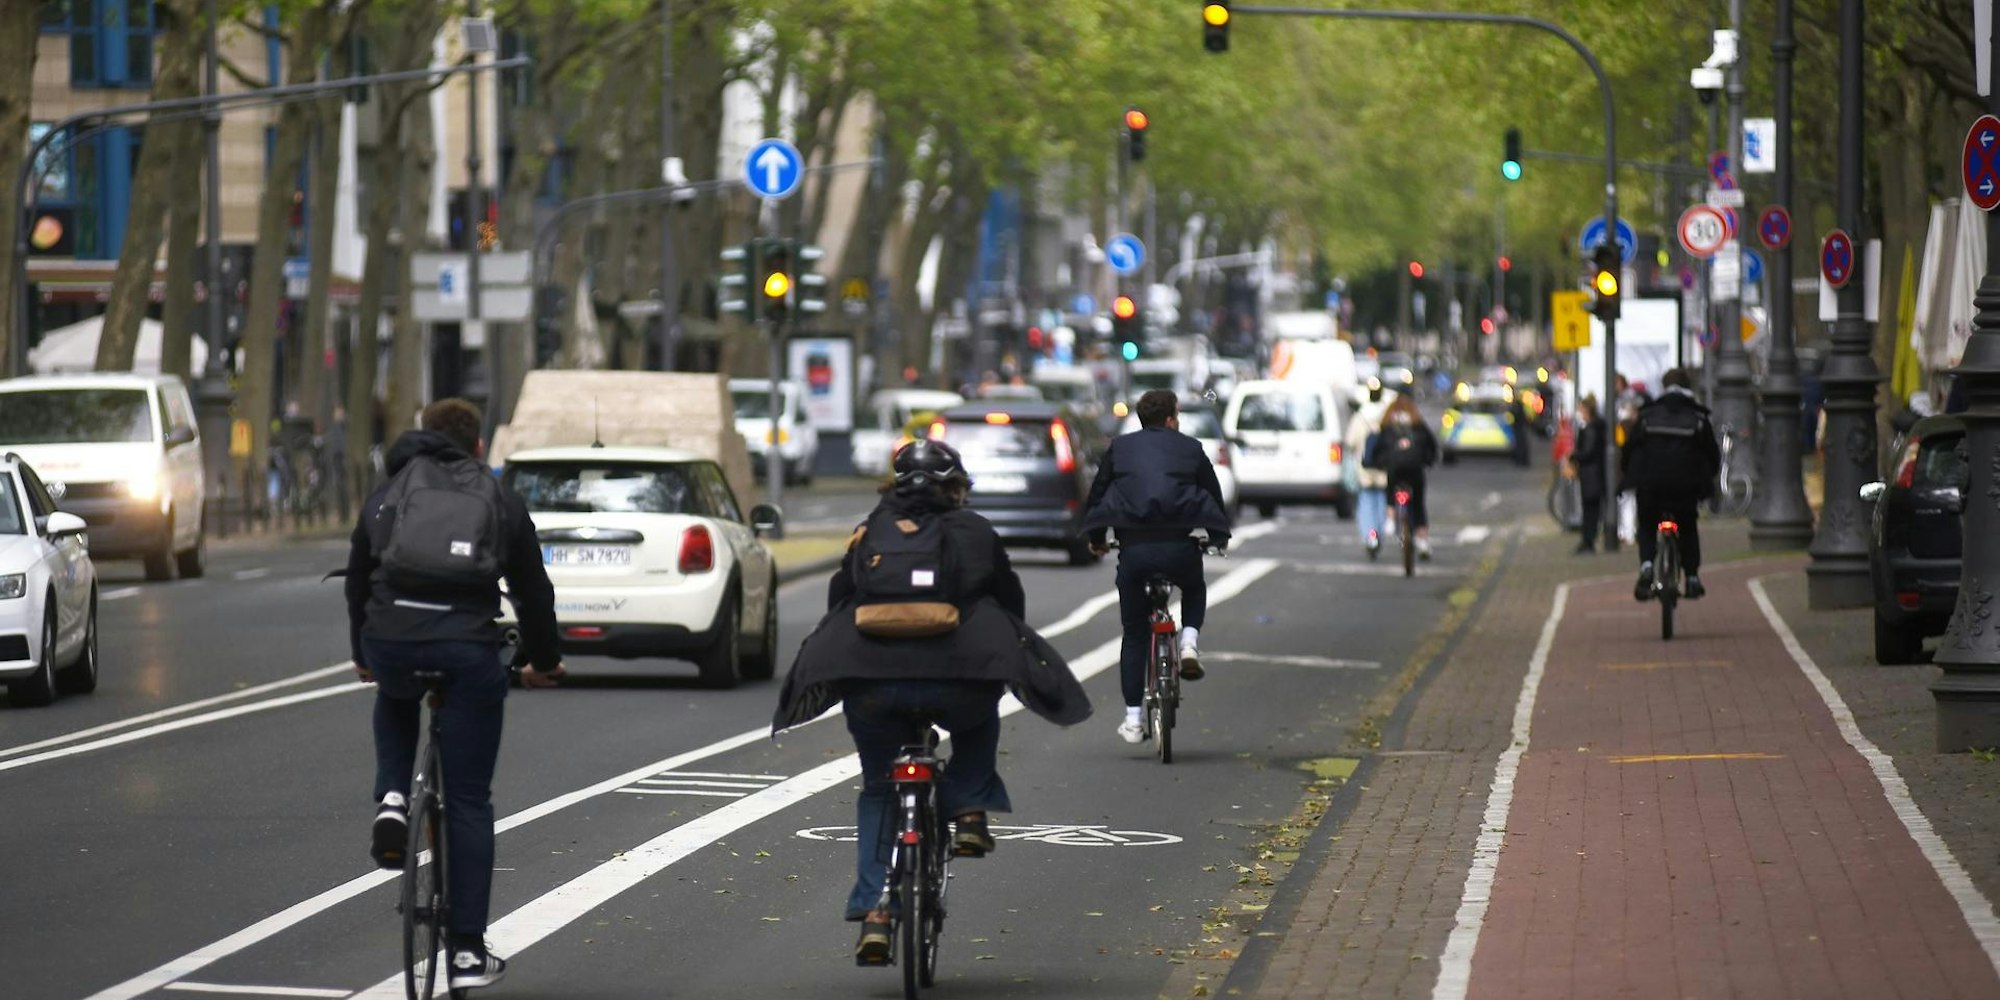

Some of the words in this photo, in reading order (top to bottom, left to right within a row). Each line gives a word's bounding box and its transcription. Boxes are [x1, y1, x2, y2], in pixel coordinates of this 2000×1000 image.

[1690, 218, 1719, 242] 30
[551, 548, 567, 562] HH
[578, 548, 594, 562] SN
[554, 602, 610, 611] HARENOW
